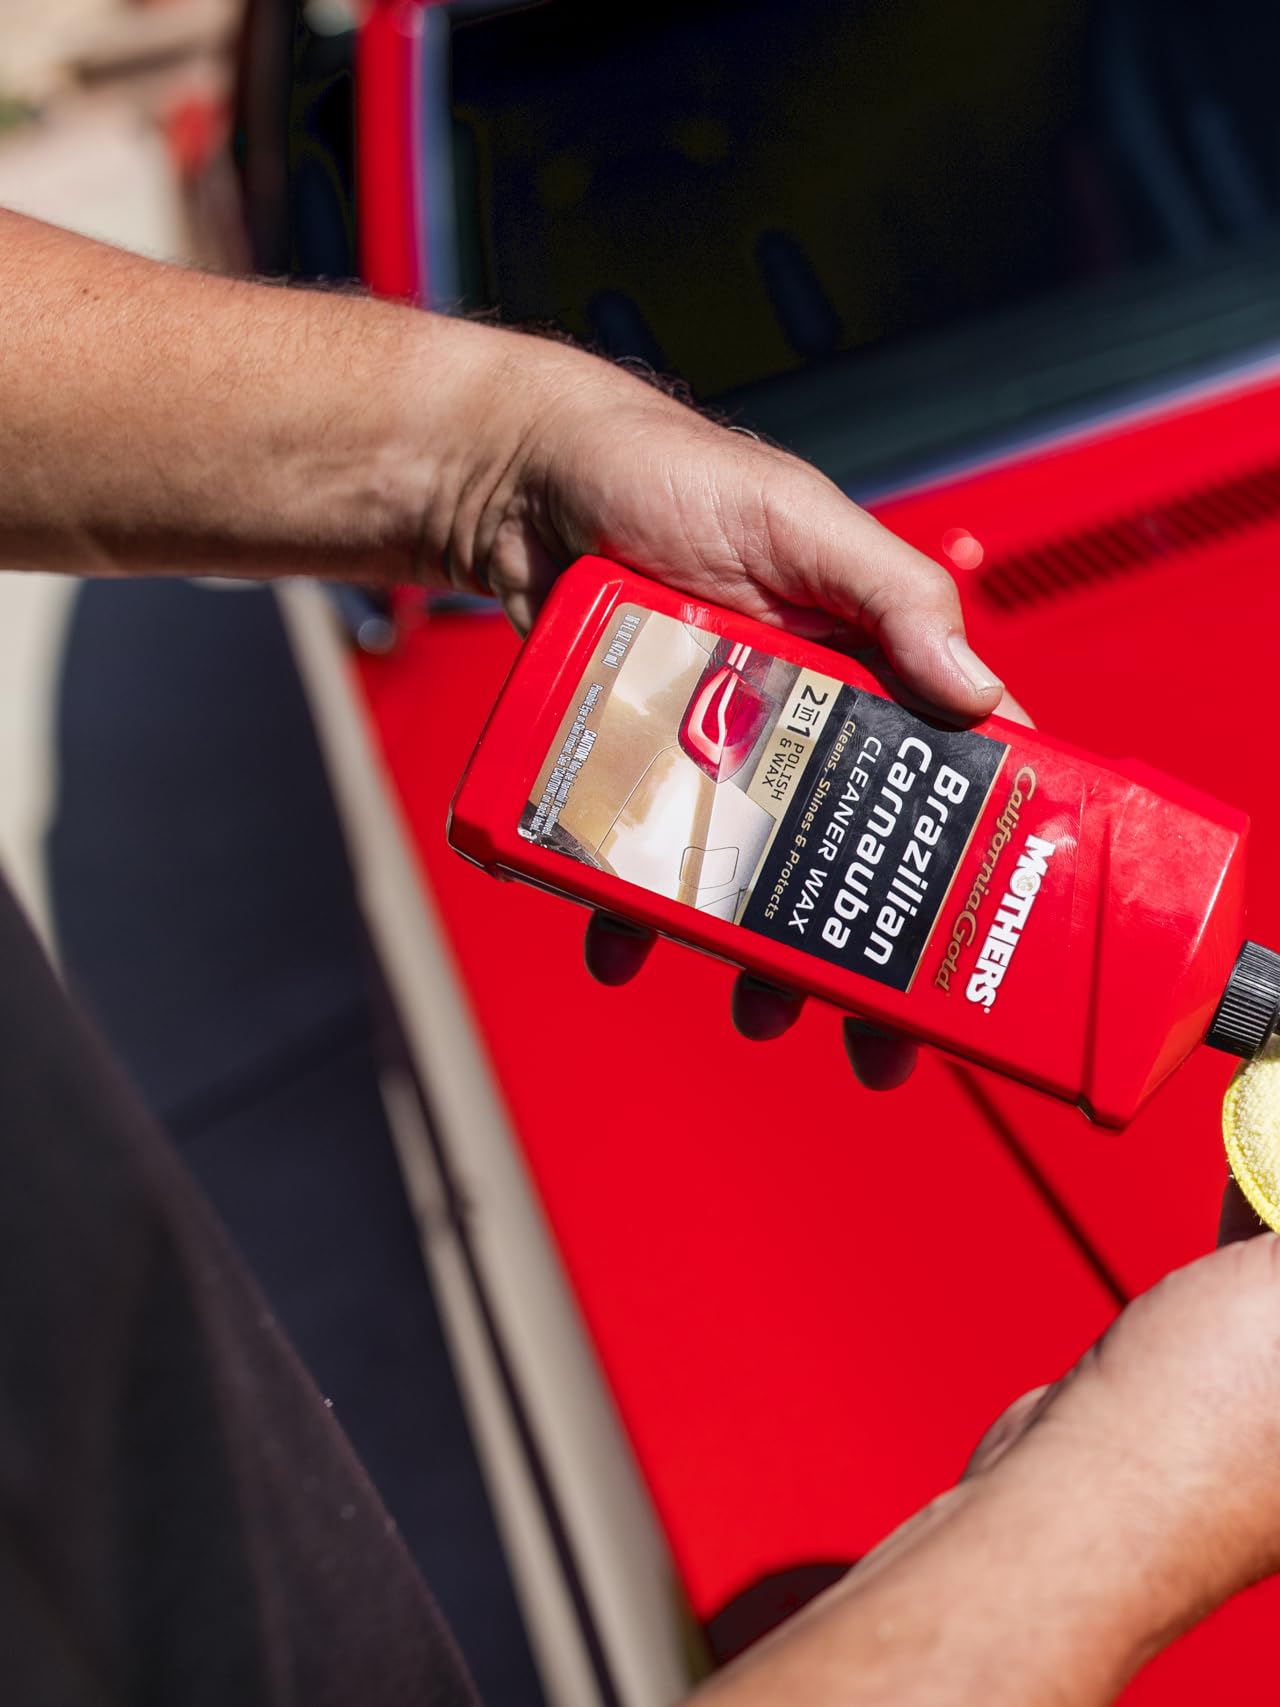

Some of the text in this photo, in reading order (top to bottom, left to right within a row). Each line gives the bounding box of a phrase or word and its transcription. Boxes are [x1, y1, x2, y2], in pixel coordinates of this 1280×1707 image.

[622, 612, 642, 625] 16
[574, 713, 587, 724] or
[575, 703, 594, 718] Eye
[568, 720, 586, 737] Skin
[570, 727, 599, 763] CAUTION:
[554, 752, 572, 767] See
[561, 758, 584, 775] May
[761, 737, 792, 787] & WAX
[562, 771, 577, 783] be
[770, 741, 804, 800] POLISH
[539, 792, 552, 804] on
[533, 800, 551, 819] back
[764, 720, 855, 919] Cleans, Shines & Protects
[788, 736, 881, 933] CLEANER WAX
[821, 736, 932, 948] Carnauba
[863, 764, 969, 964] Brazilian
[967, 834, 1057, 1010] MOTHERS
